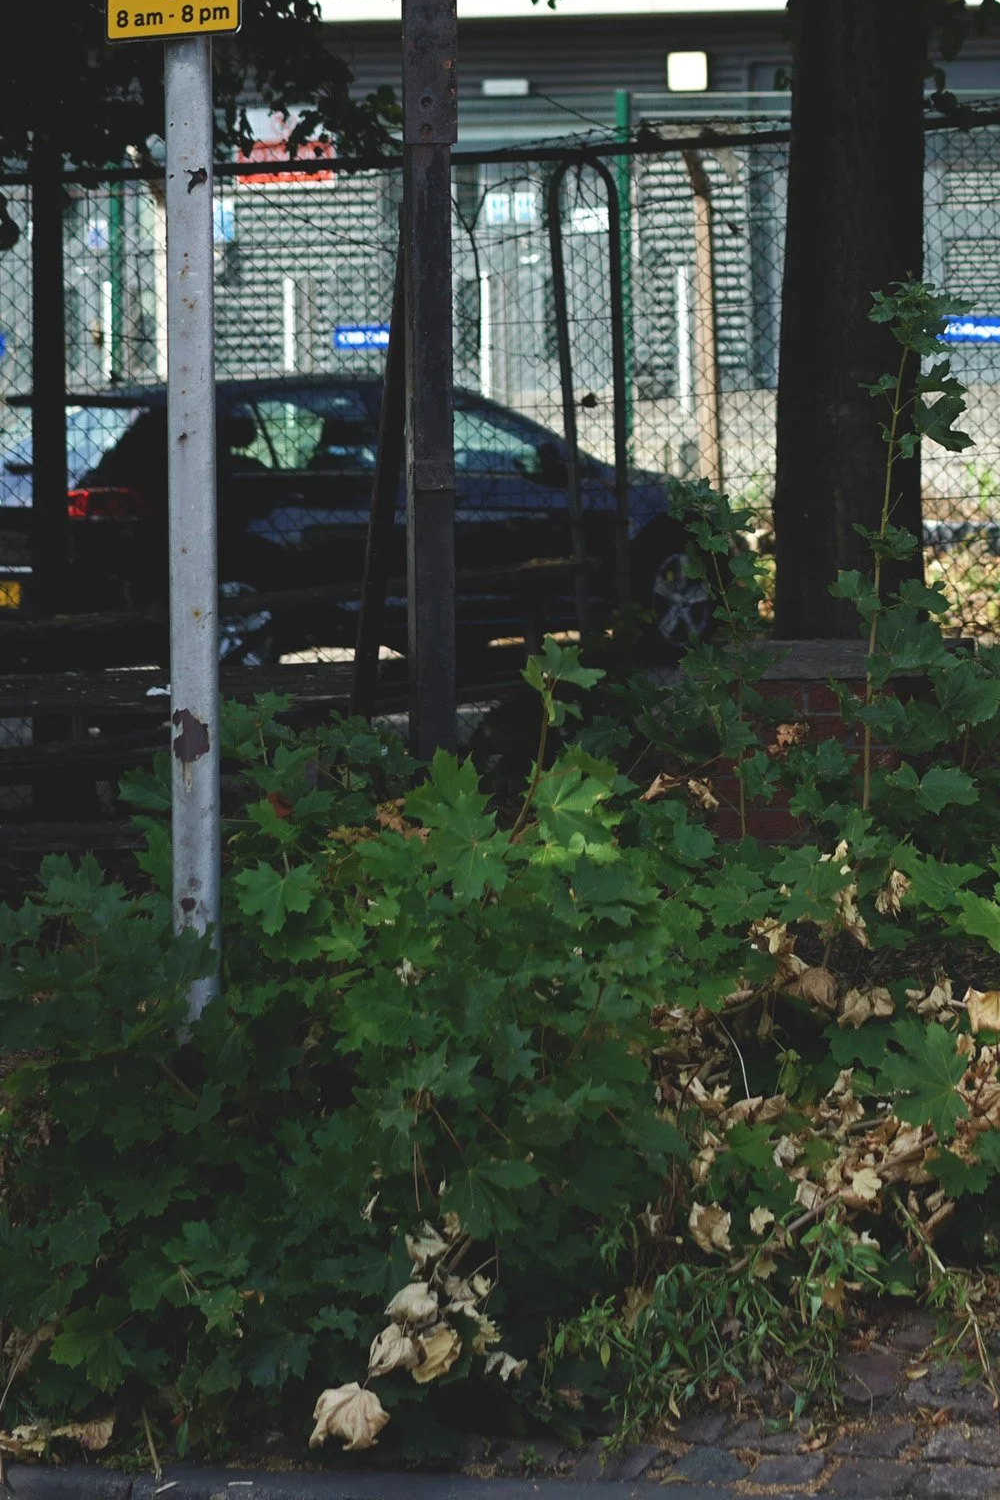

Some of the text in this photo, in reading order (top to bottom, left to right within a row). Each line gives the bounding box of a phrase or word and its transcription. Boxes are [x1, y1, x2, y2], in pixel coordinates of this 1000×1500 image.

[116, 9, 129, 28] 8
[134, 10, 164, 27] am
[181, 3, 194, 23] 8
[199, 5, 230, 25] pm
